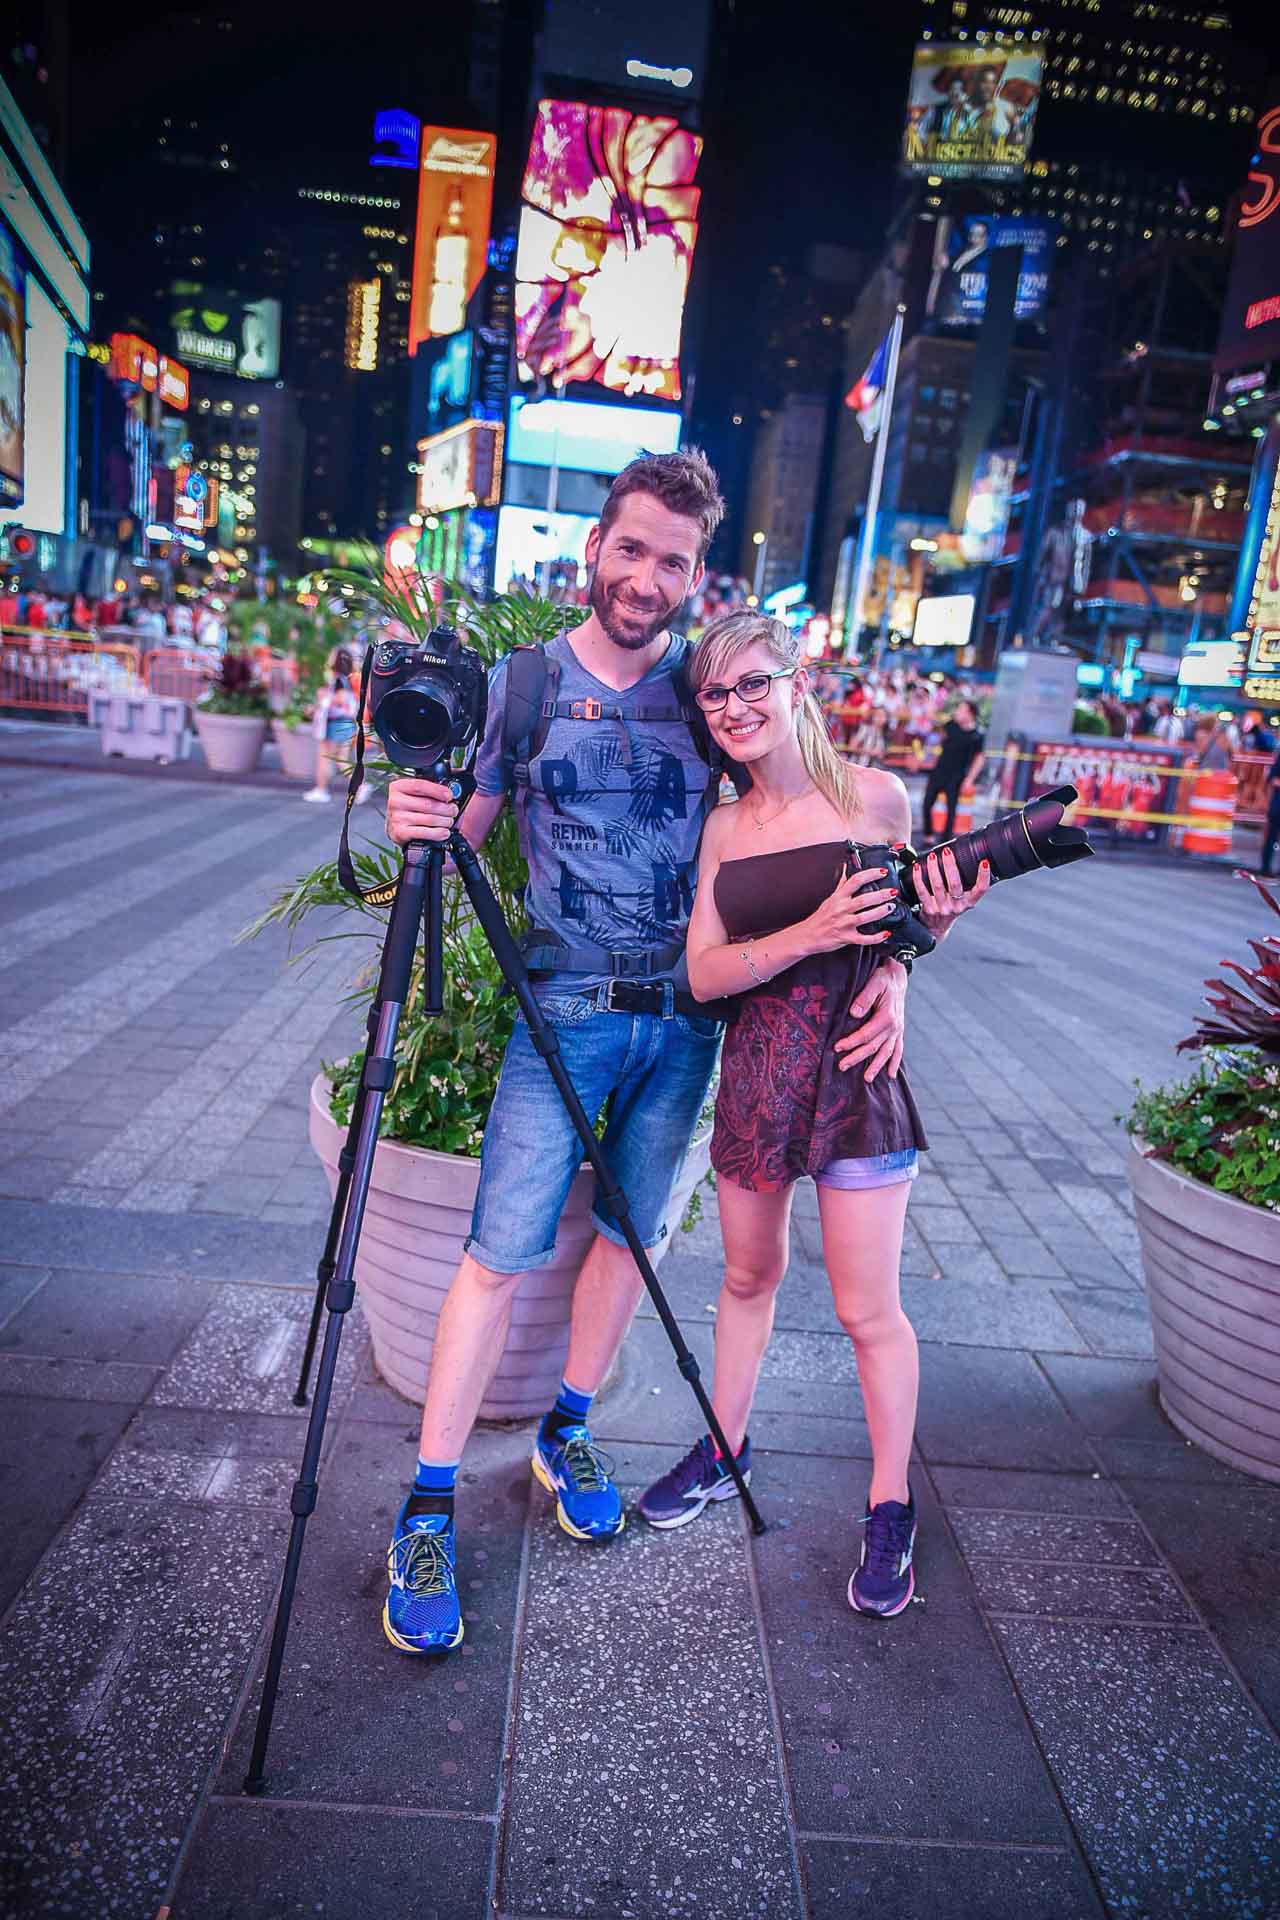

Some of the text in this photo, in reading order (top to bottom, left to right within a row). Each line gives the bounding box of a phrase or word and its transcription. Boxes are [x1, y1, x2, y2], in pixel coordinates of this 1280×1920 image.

[423, 654, 447, 665] Nikon
[551, 822, 598, 841] RETRO
[551, 840, 599, 851] SUMMER
